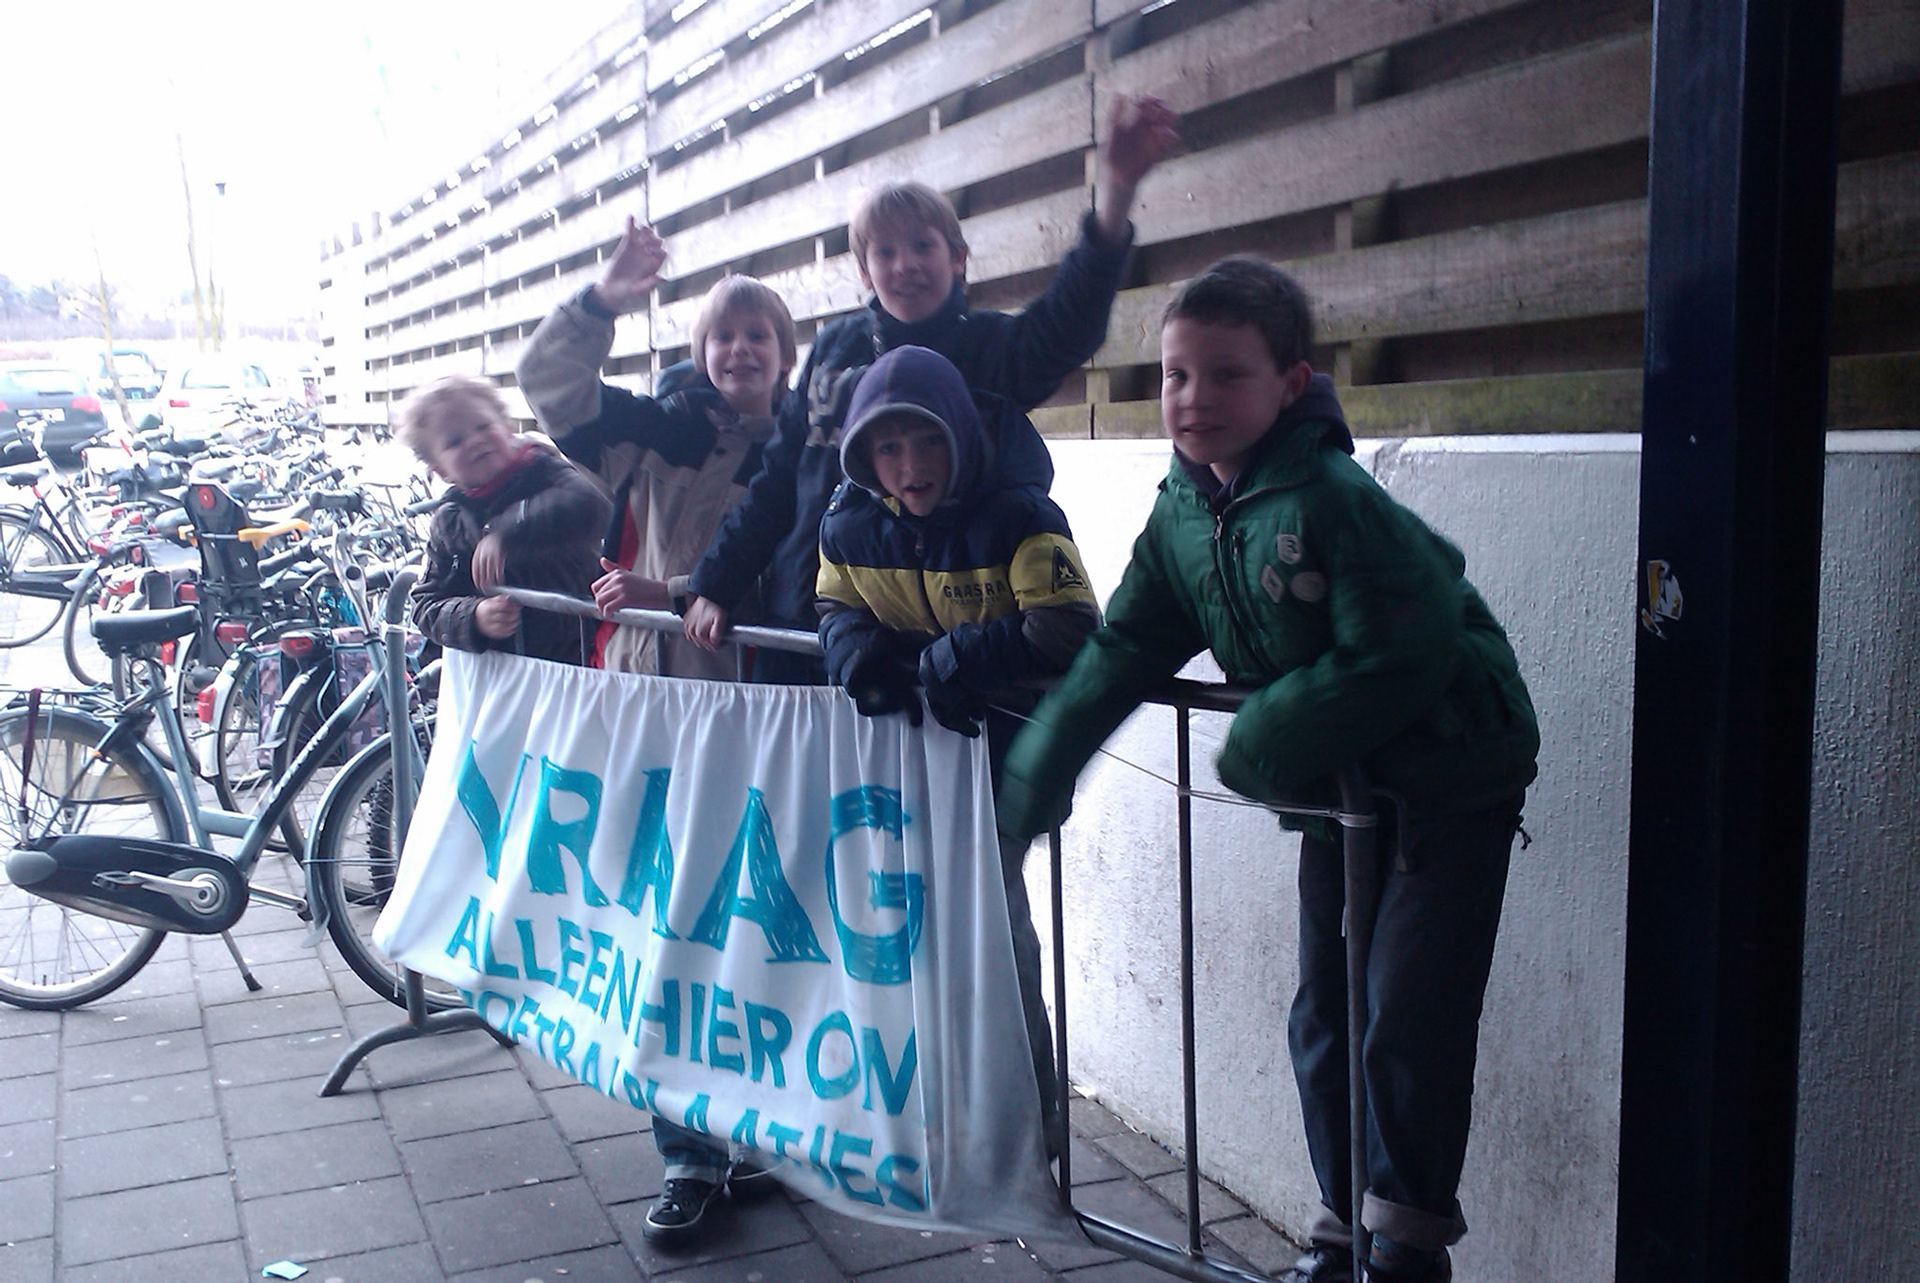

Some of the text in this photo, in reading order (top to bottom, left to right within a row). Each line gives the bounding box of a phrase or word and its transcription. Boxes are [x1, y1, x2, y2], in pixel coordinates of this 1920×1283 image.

[457, 740, 926, 985] VRAAG
[445, 895, 642, 1035] ALLEEN
[632, 966, 793, 1089] HIER
